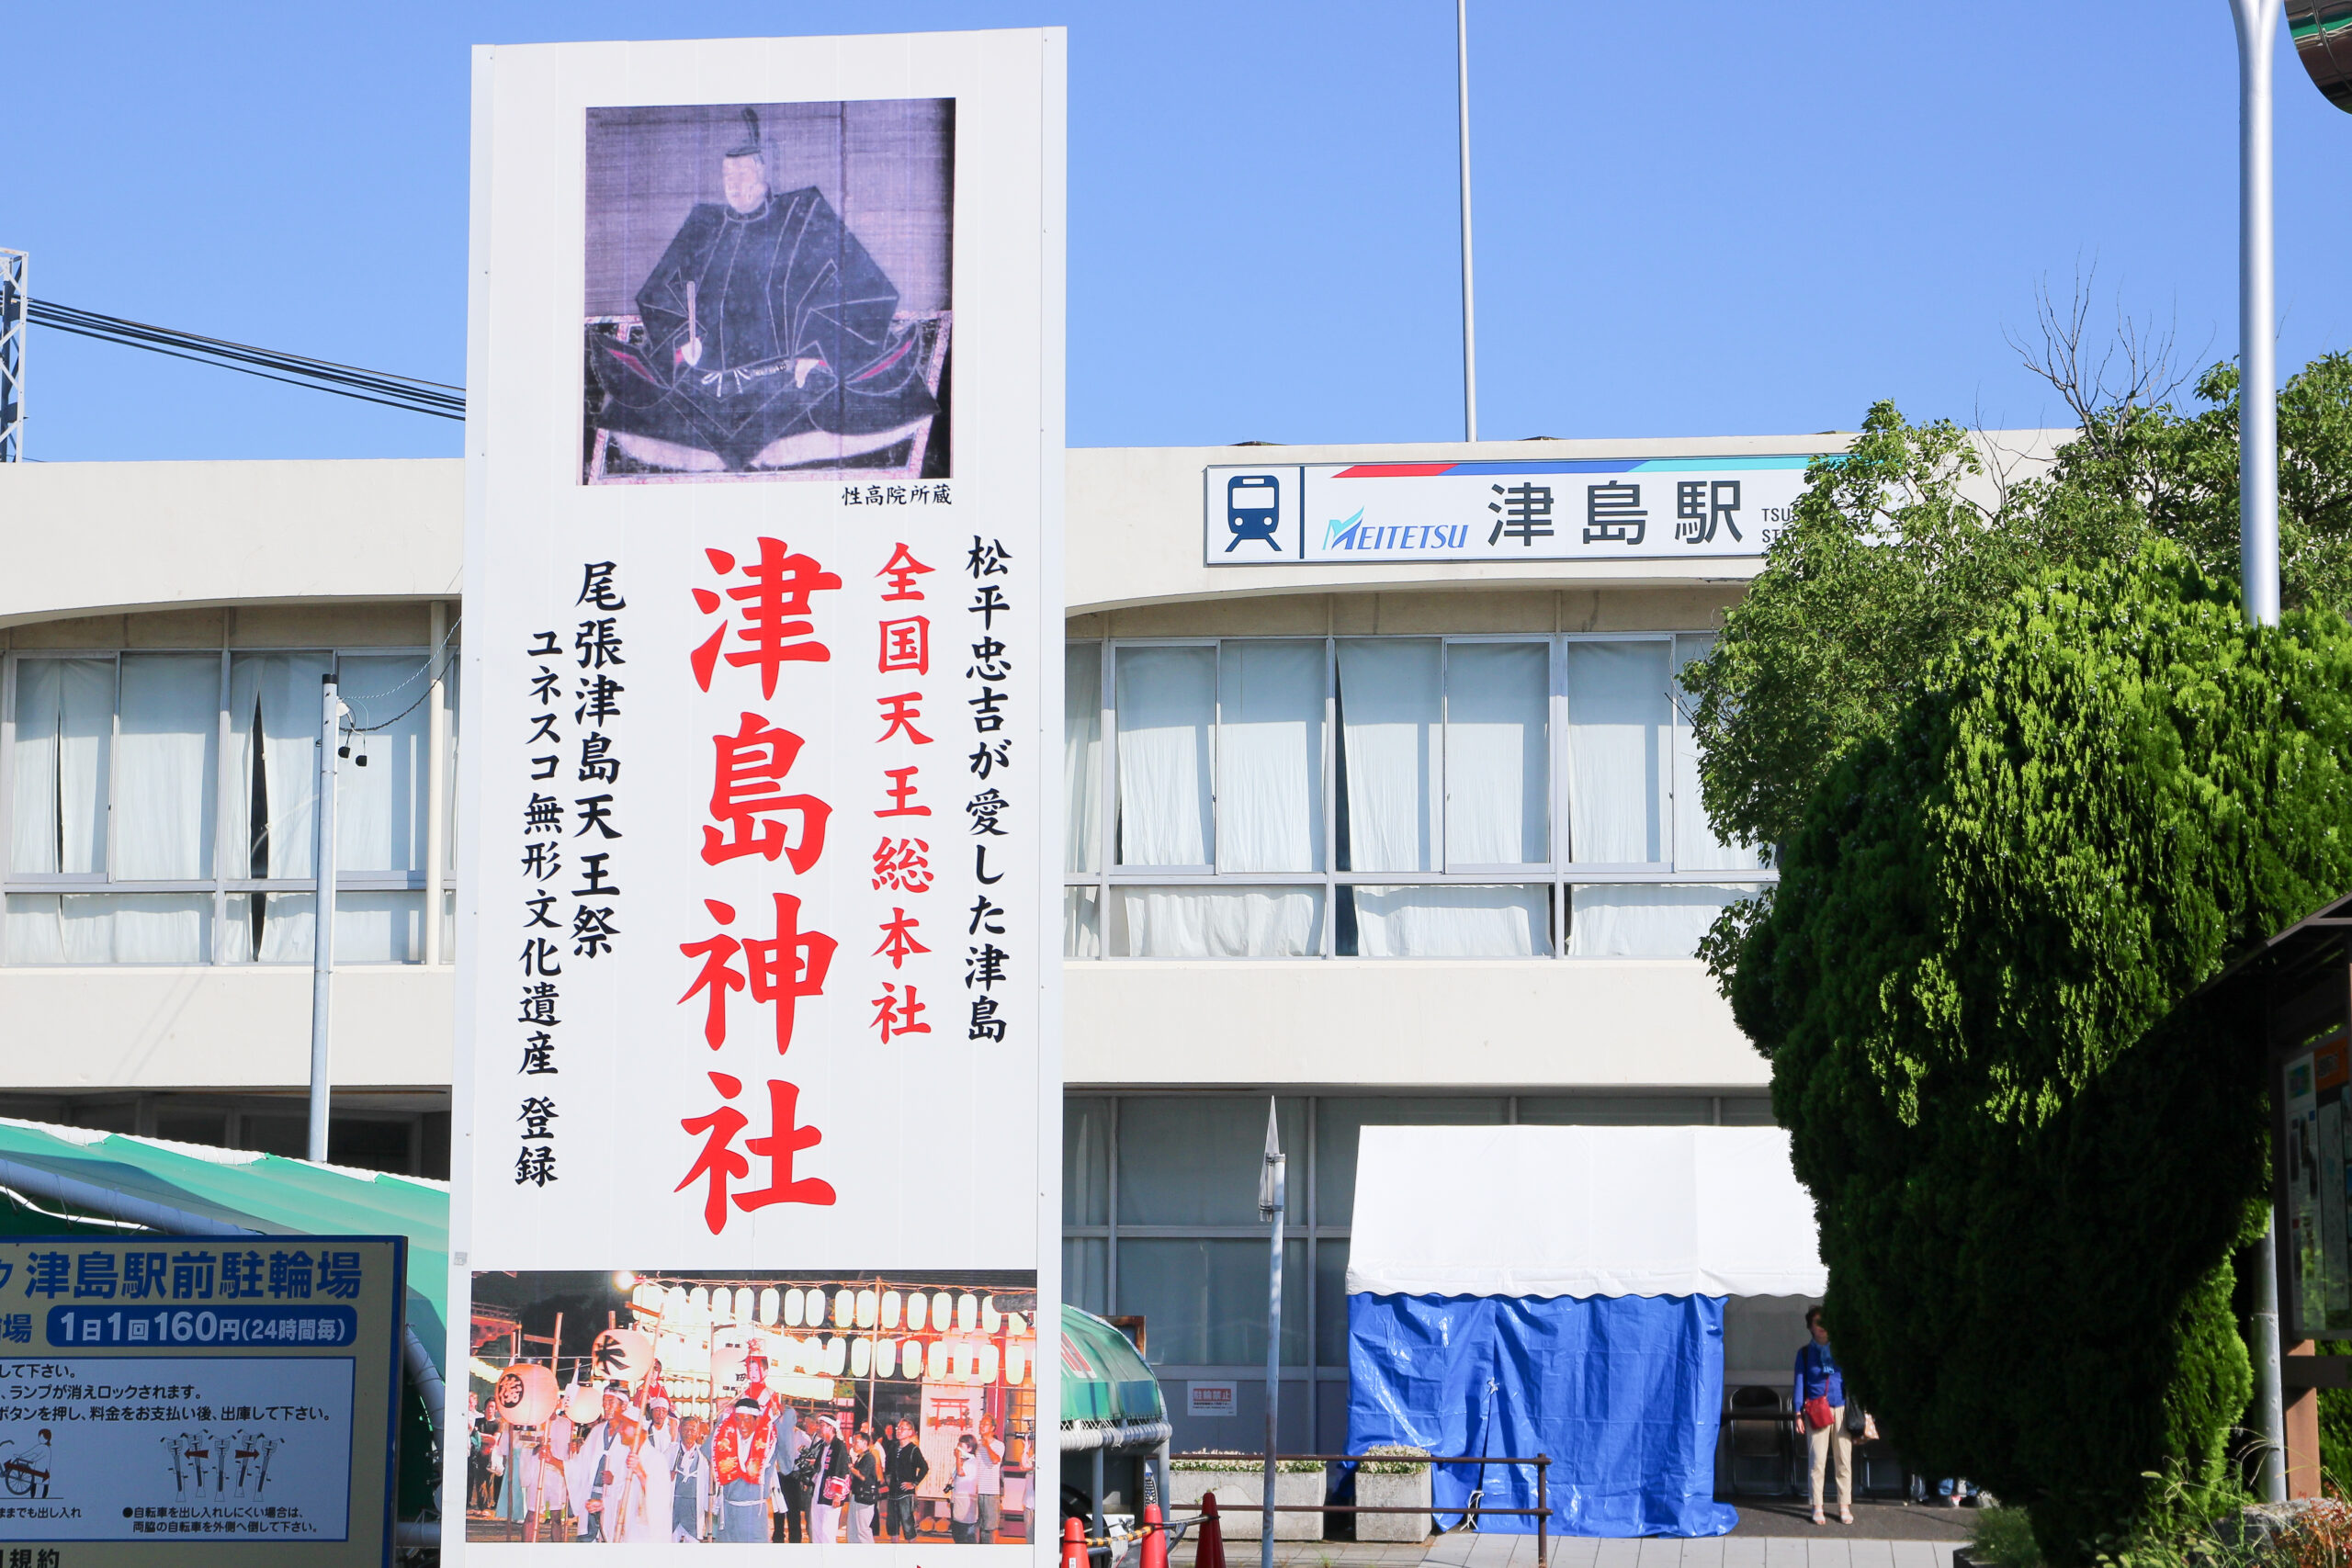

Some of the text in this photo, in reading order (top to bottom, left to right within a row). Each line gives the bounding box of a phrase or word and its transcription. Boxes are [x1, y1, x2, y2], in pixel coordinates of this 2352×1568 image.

[842, 483, 952, 506] 性高院所蔵
[1487, 479, 1742, 547] 津島駅
[1322, 505, 1468, 550] MEITETSU
[570, 560, 627, 959] 尾張津島天王祭
[869, 542, 936, 1045] 全国天王総本社
[965, 535, 1012, 1043] 松平忠吉が愛した津島
[673, 536, 842, 1235] 津島神社
[25, 1251, 362, 1299] 津島駅前駐輪場
[0, 1313, 32, 1343] 場
[0, 1549, 60, 1568] 規約
